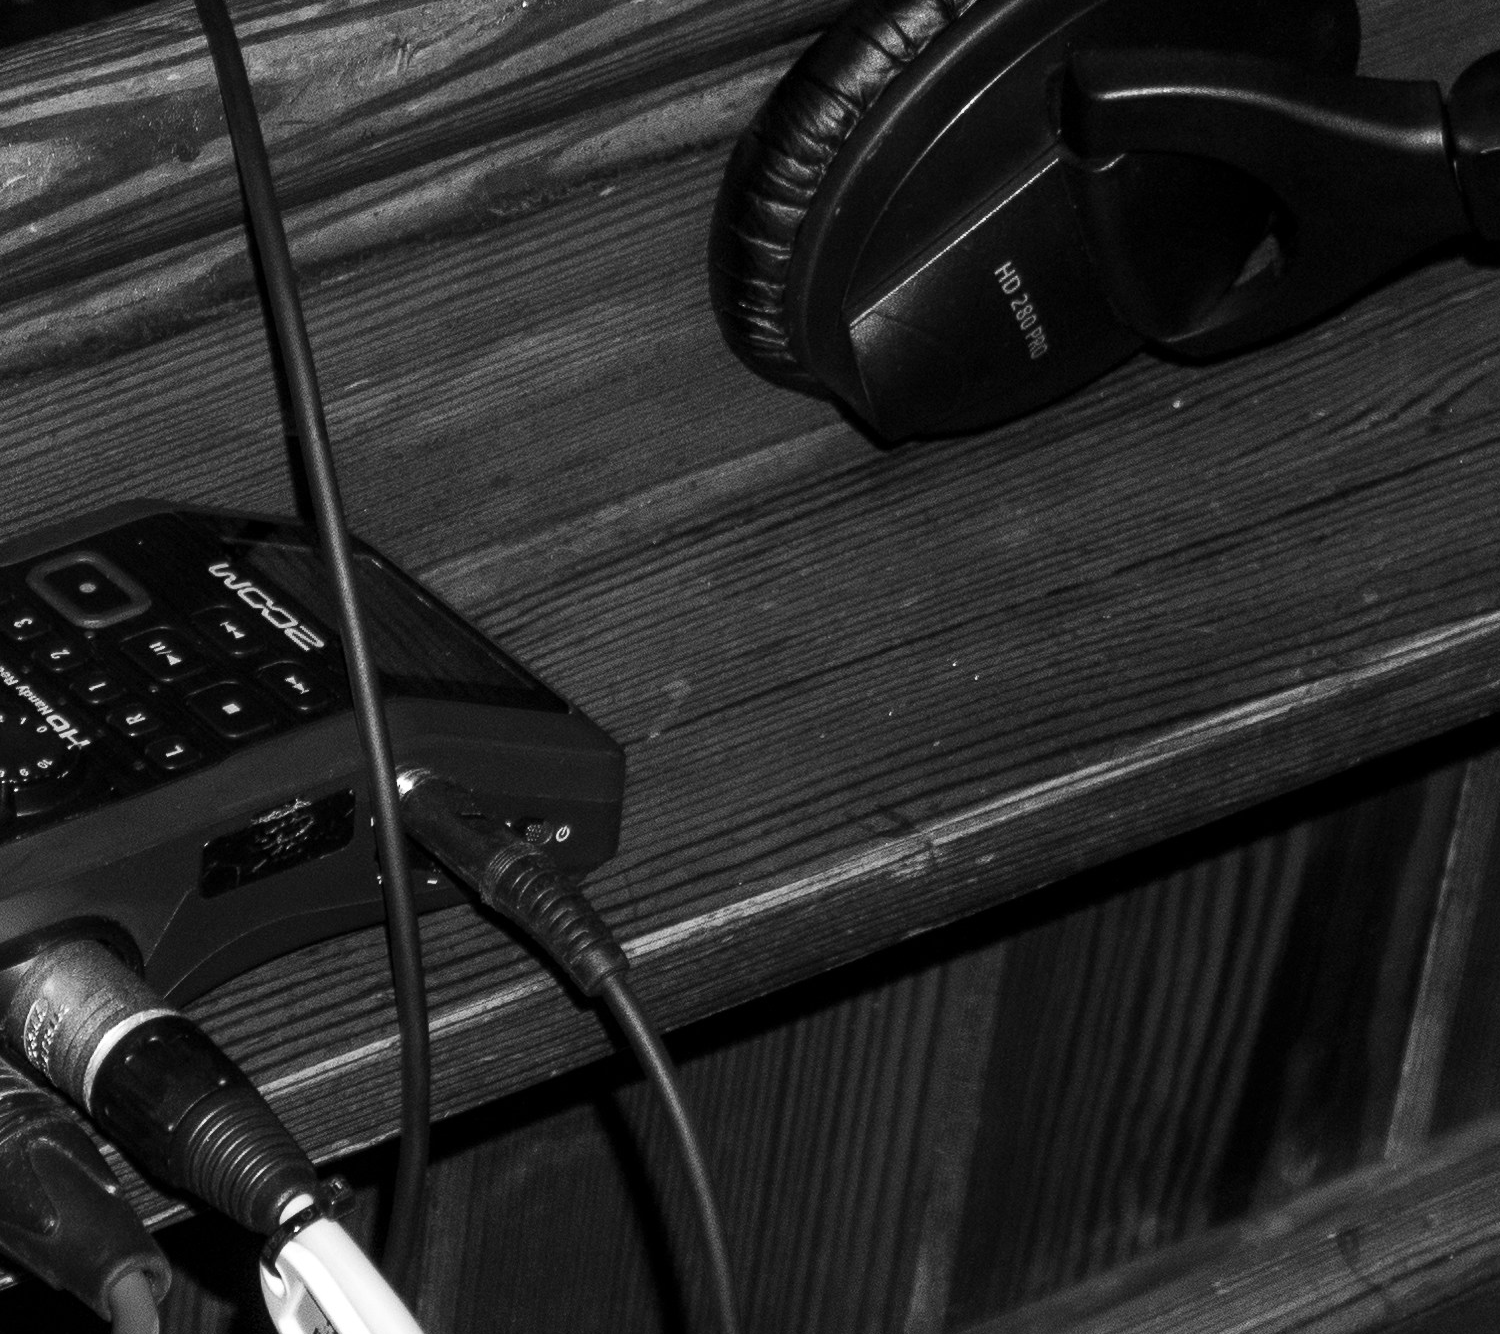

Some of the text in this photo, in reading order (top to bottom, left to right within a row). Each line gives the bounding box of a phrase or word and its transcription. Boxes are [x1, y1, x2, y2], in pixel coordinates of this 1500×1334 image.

[993, 259, 1049, 360] HD 280 PRO
[13, 617, 33, 629] 3
[50, 648, 71, 660] 2
[15, 684, 55, 716] Handy
[125, 712, 147, 726] R
[165, 744, 184, 758] L
